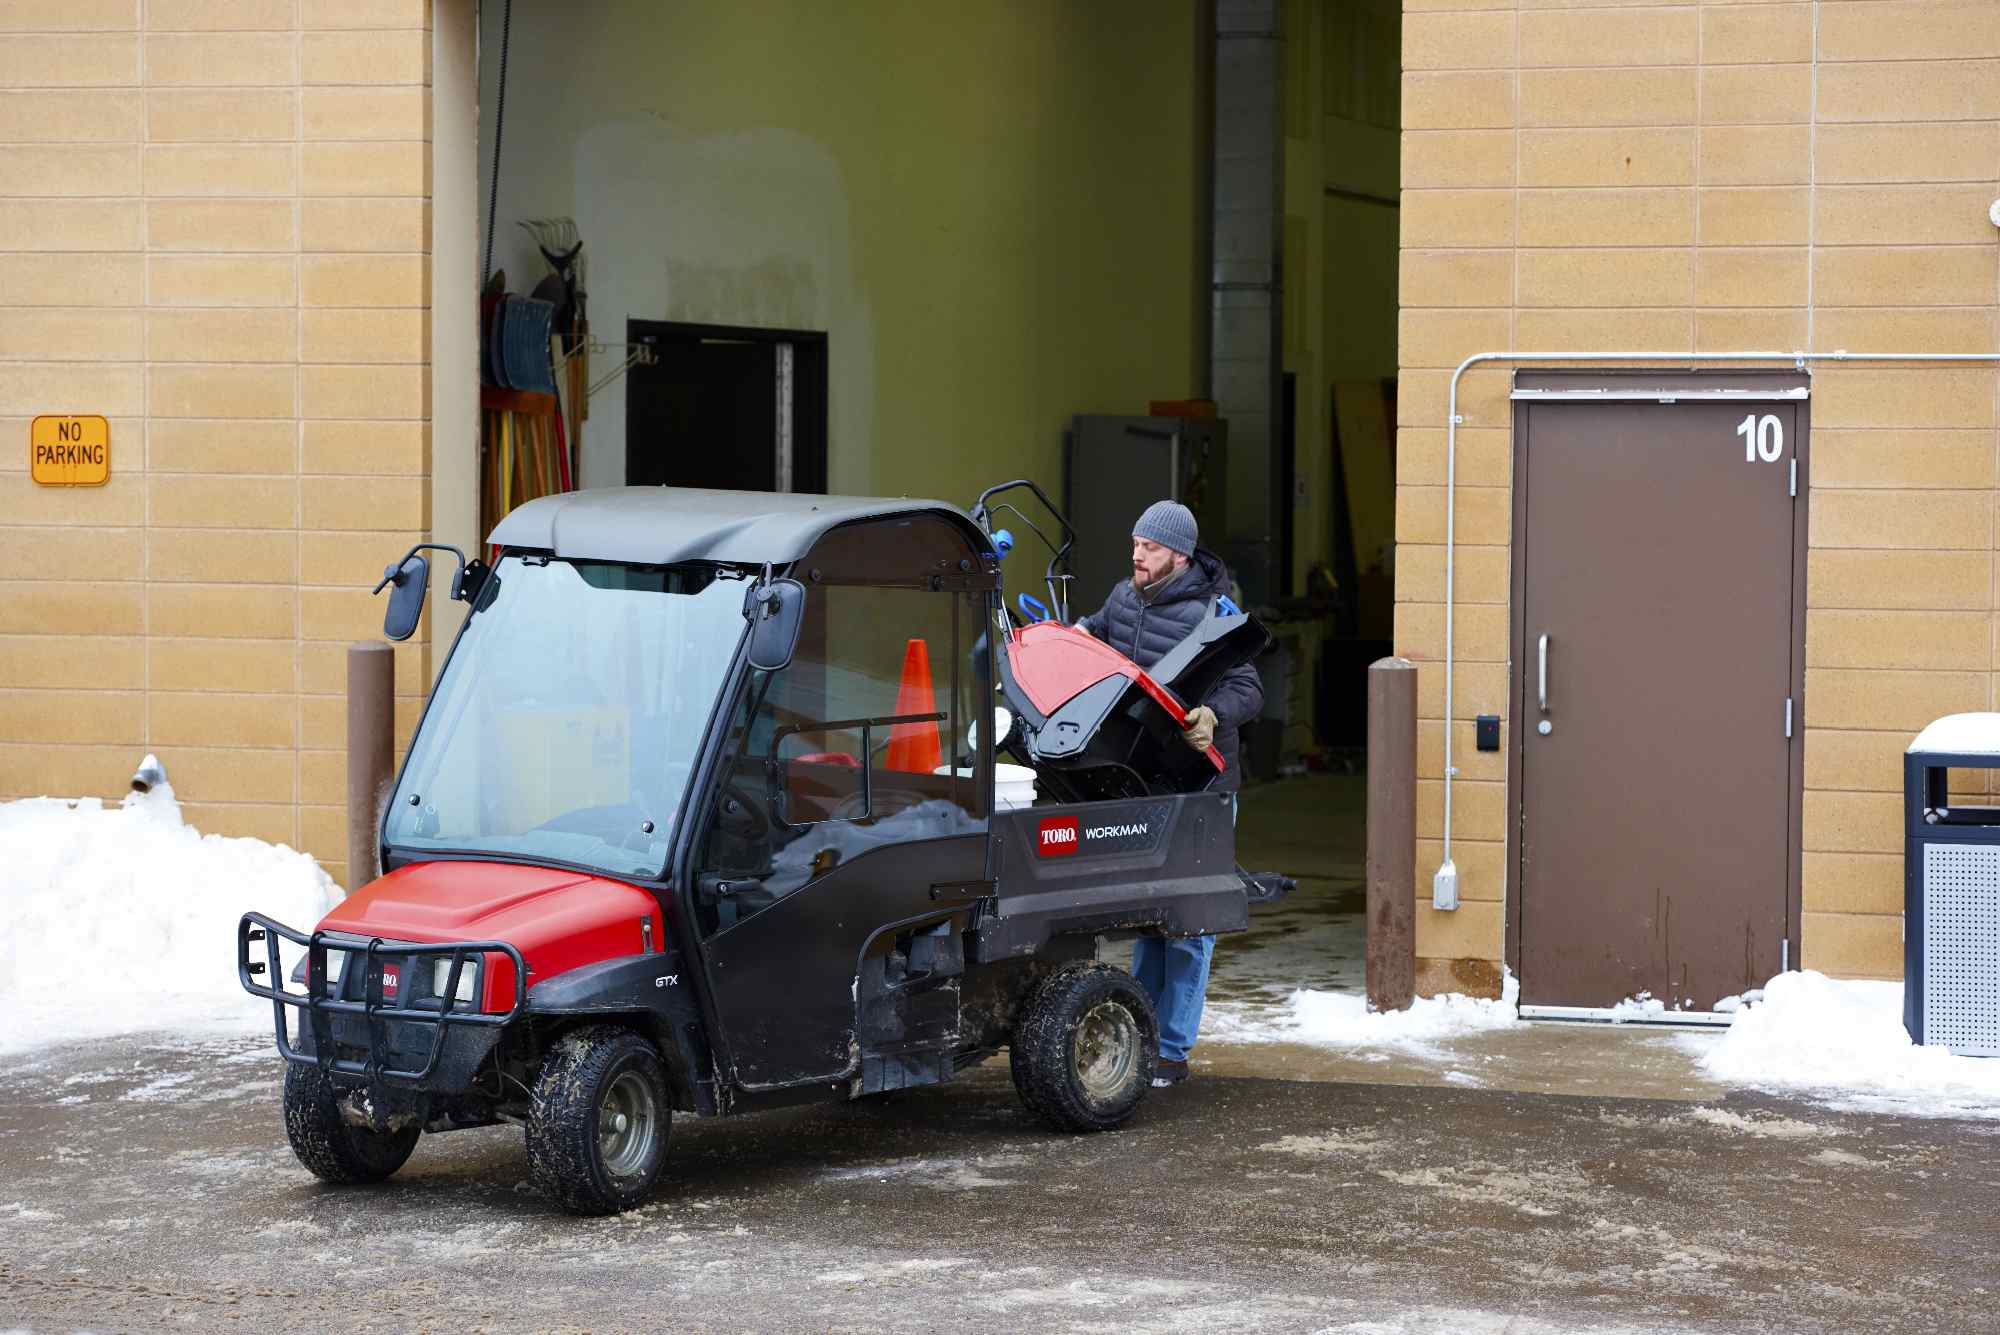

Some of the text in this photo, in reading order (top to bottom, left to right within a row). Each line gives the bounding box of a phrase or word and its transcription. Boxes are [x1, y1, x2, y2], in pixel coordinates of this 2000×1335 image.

[58, 422, 81, 442] NO
[1737, 414, 1783, 463] 10
[36, 445, 104, 465] PARKING
[1041, 823, 1149, 845] TORO WORKMAN
[655, 974, 679, 988] GTX
